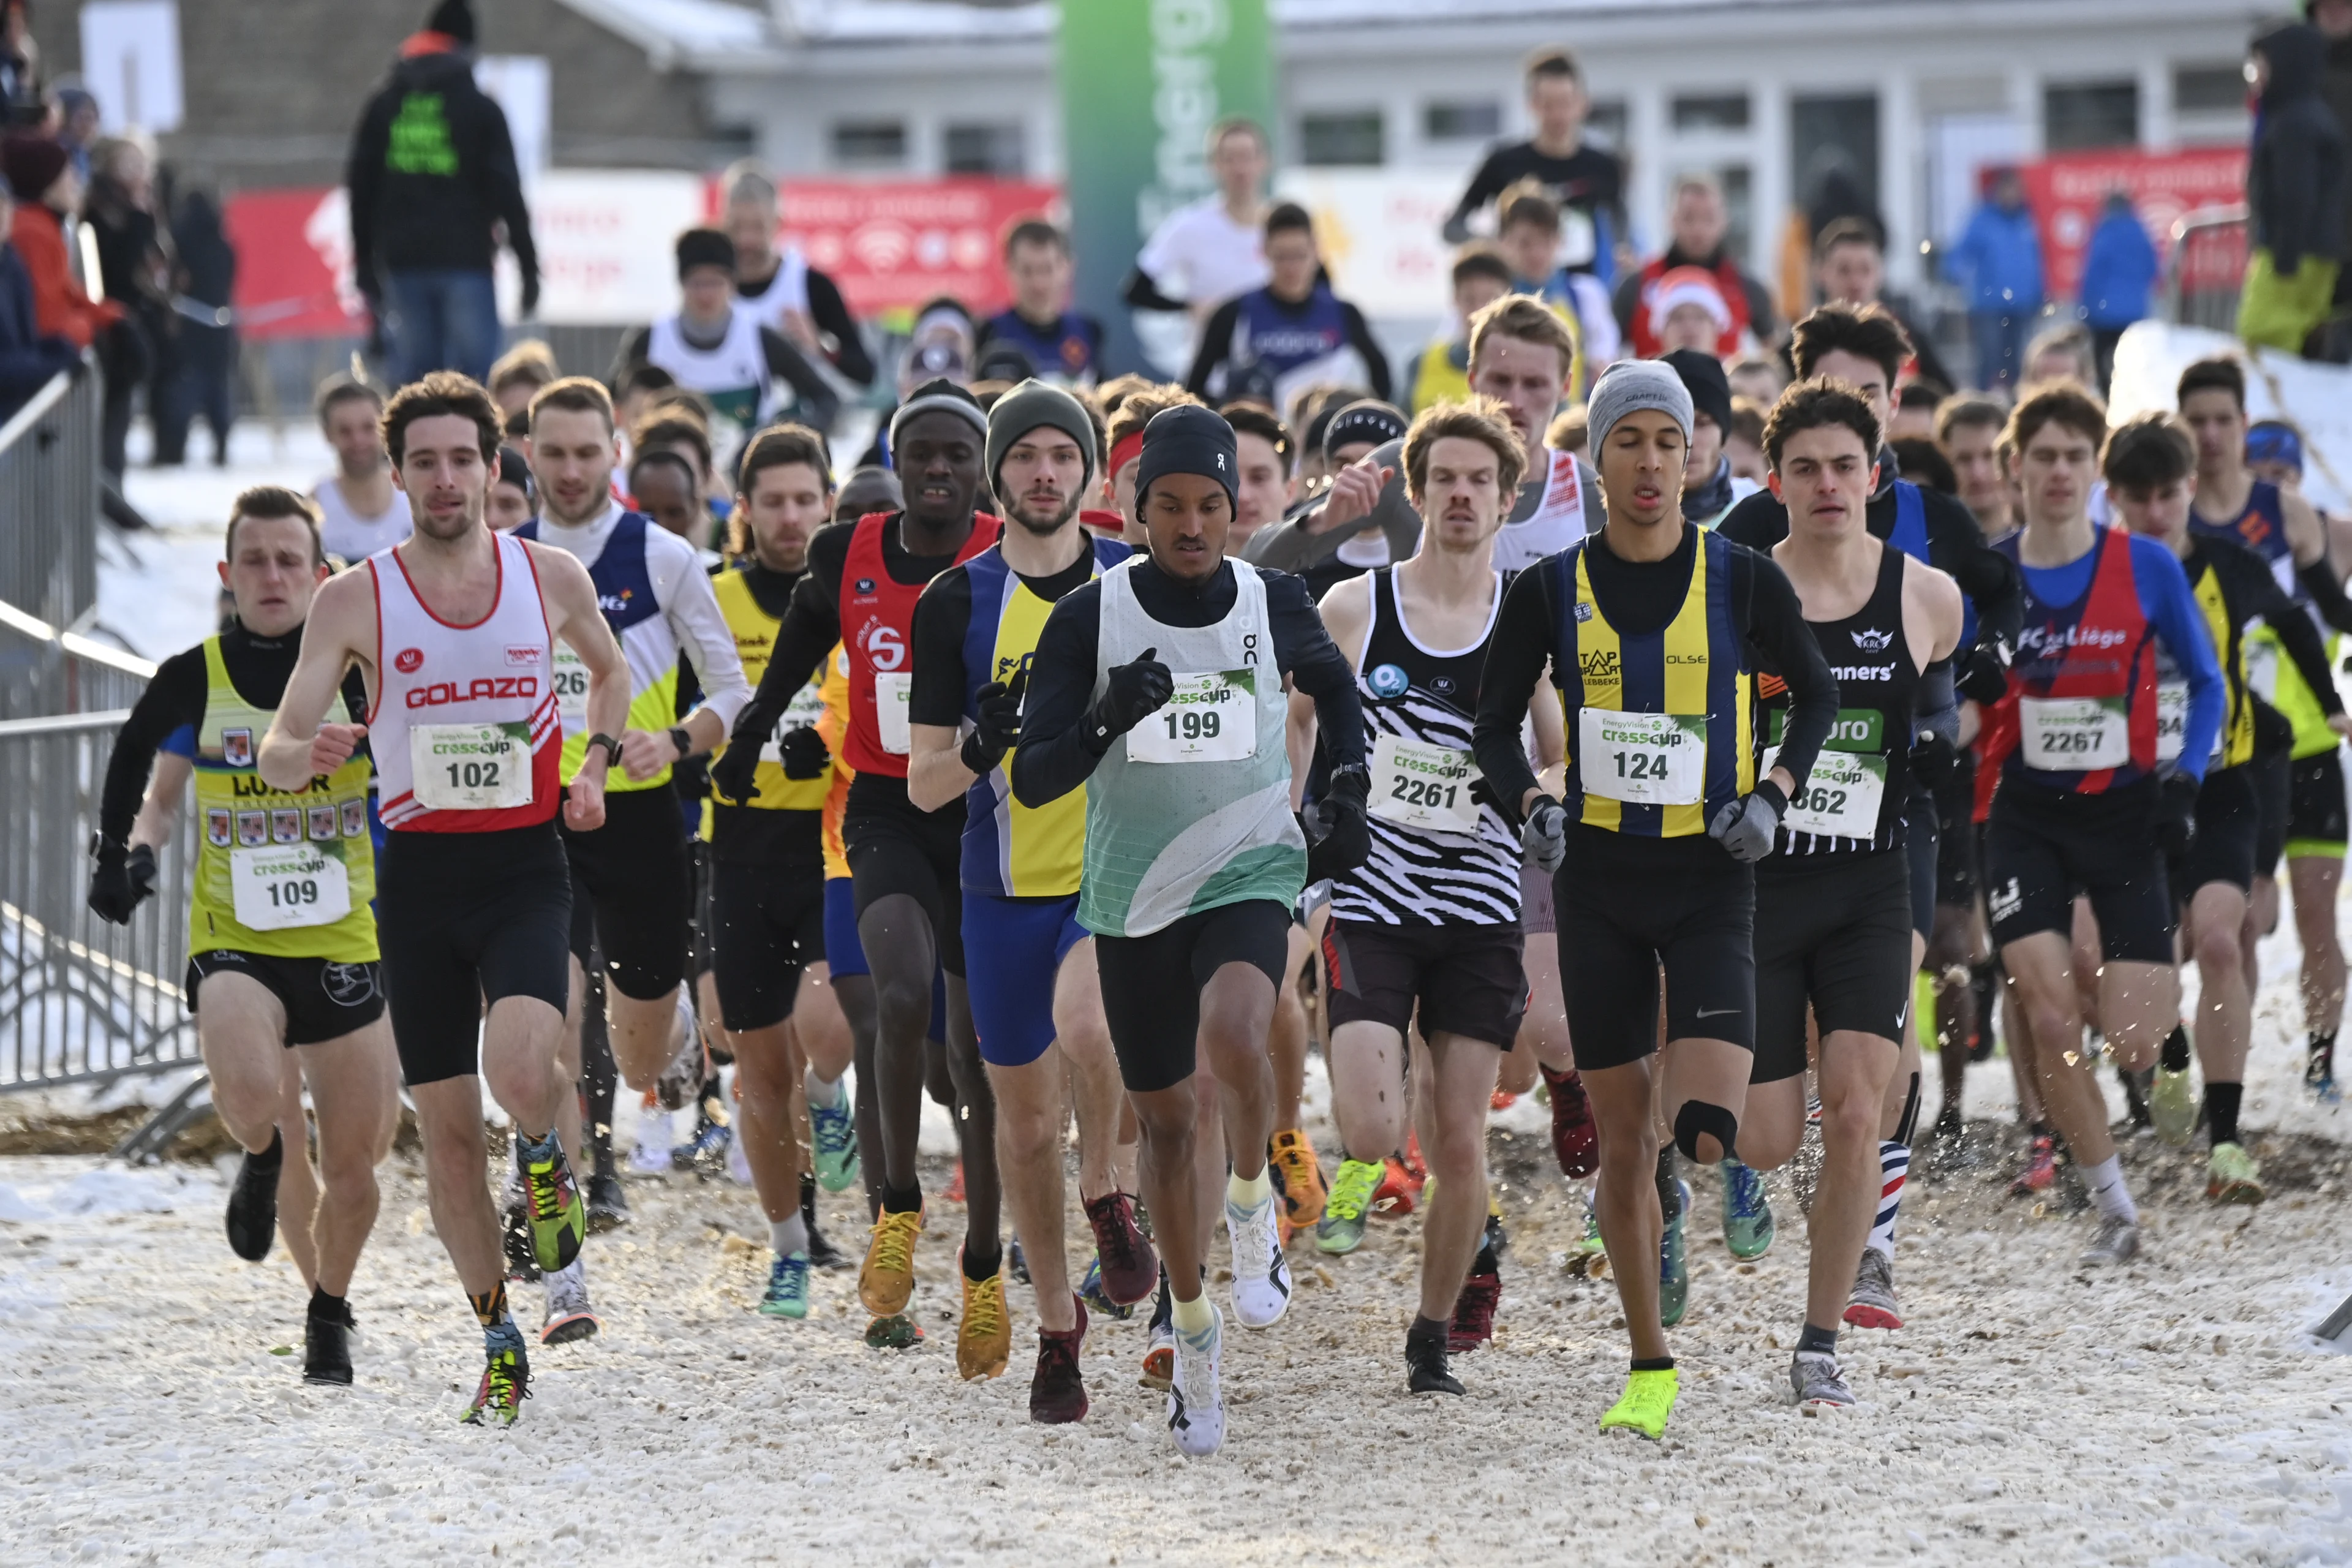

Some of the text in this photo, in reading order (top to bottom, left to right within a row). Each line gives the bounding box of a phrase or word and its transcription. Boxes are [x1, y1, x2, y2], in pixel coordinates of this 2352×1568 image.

[1666, 655, 1707, 664] OLSE
[405, 676, 538, 709] GOLAZO
[554, 672, 590, 695] 26
[1169, 689, 1231, 704] osscup
[1164, 711, 1221, 740] 199
[1602, 718, 1649, 729] EnergyVision
[1395, 745, 1440, 761] EnergyVision
[2041, 730, 2105, 753] 2267
[446, 762, 500, 788] 102
[1613, 752, 1668, 781] 124
[1811, 768, 1863, 785] sscup
[232, 775, 331, 796] LUR
[1391, 774, 1458, 809] 2261
[267, 879, 318, 907] 109
